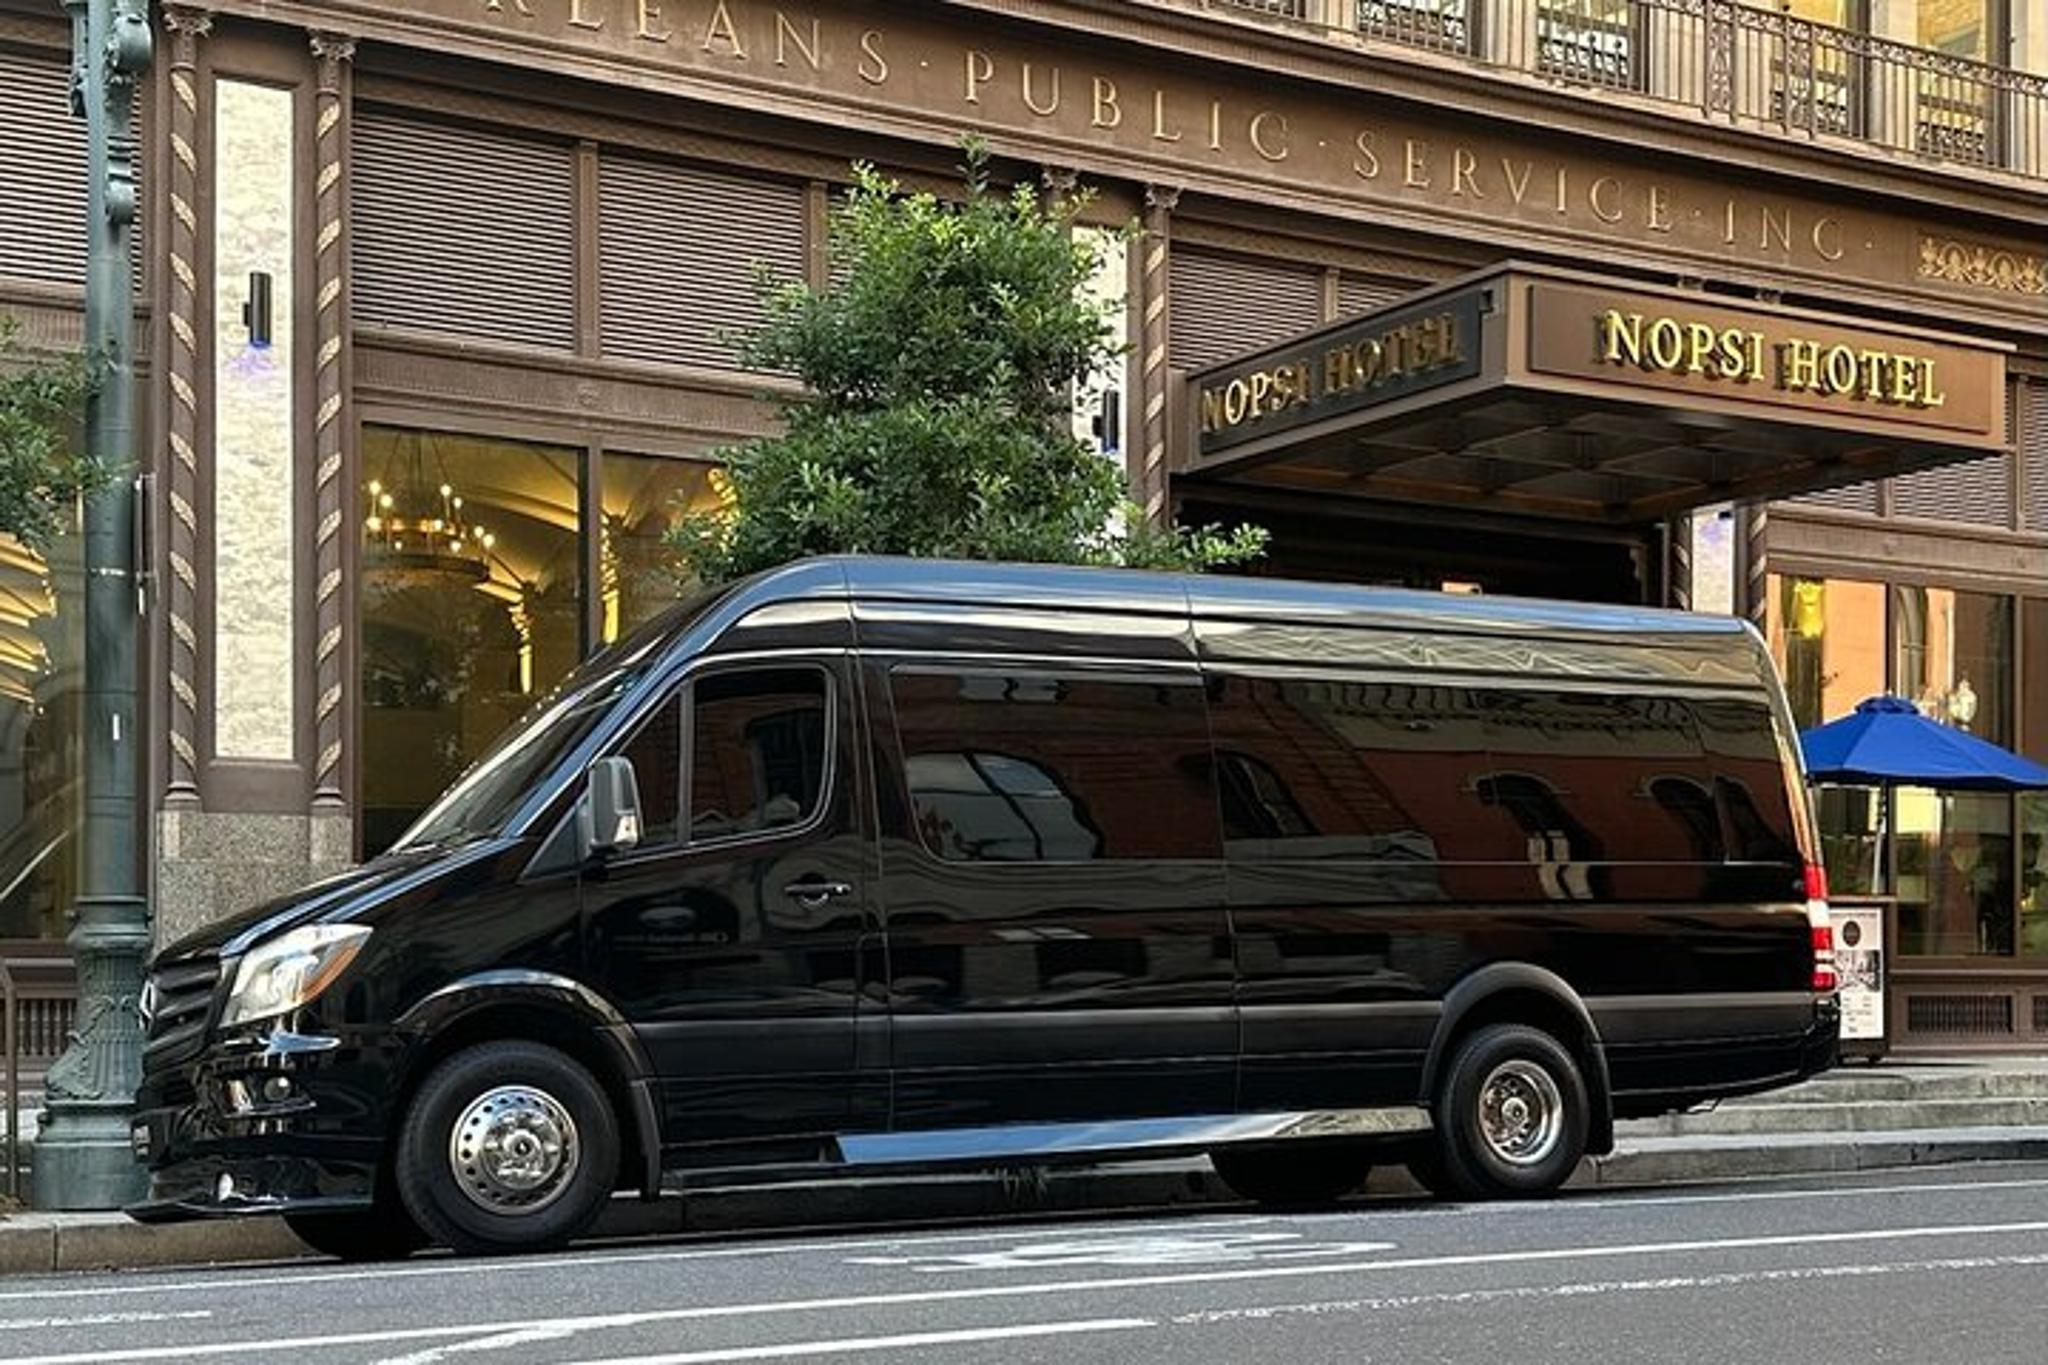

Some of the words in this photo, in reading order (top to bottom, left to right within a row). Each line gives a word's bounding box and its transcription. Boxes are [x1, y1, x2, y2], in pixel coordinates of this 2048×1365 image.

[963, 50, 1289, 161] PUBLIC
[1353, 130, 1672, 232] SERVICE
[1200, 357, 1311, 433] NOPSI
[1604, 309, 1764, 381] NOPSI
[1787, 339, 1944, 405] HOTEL
